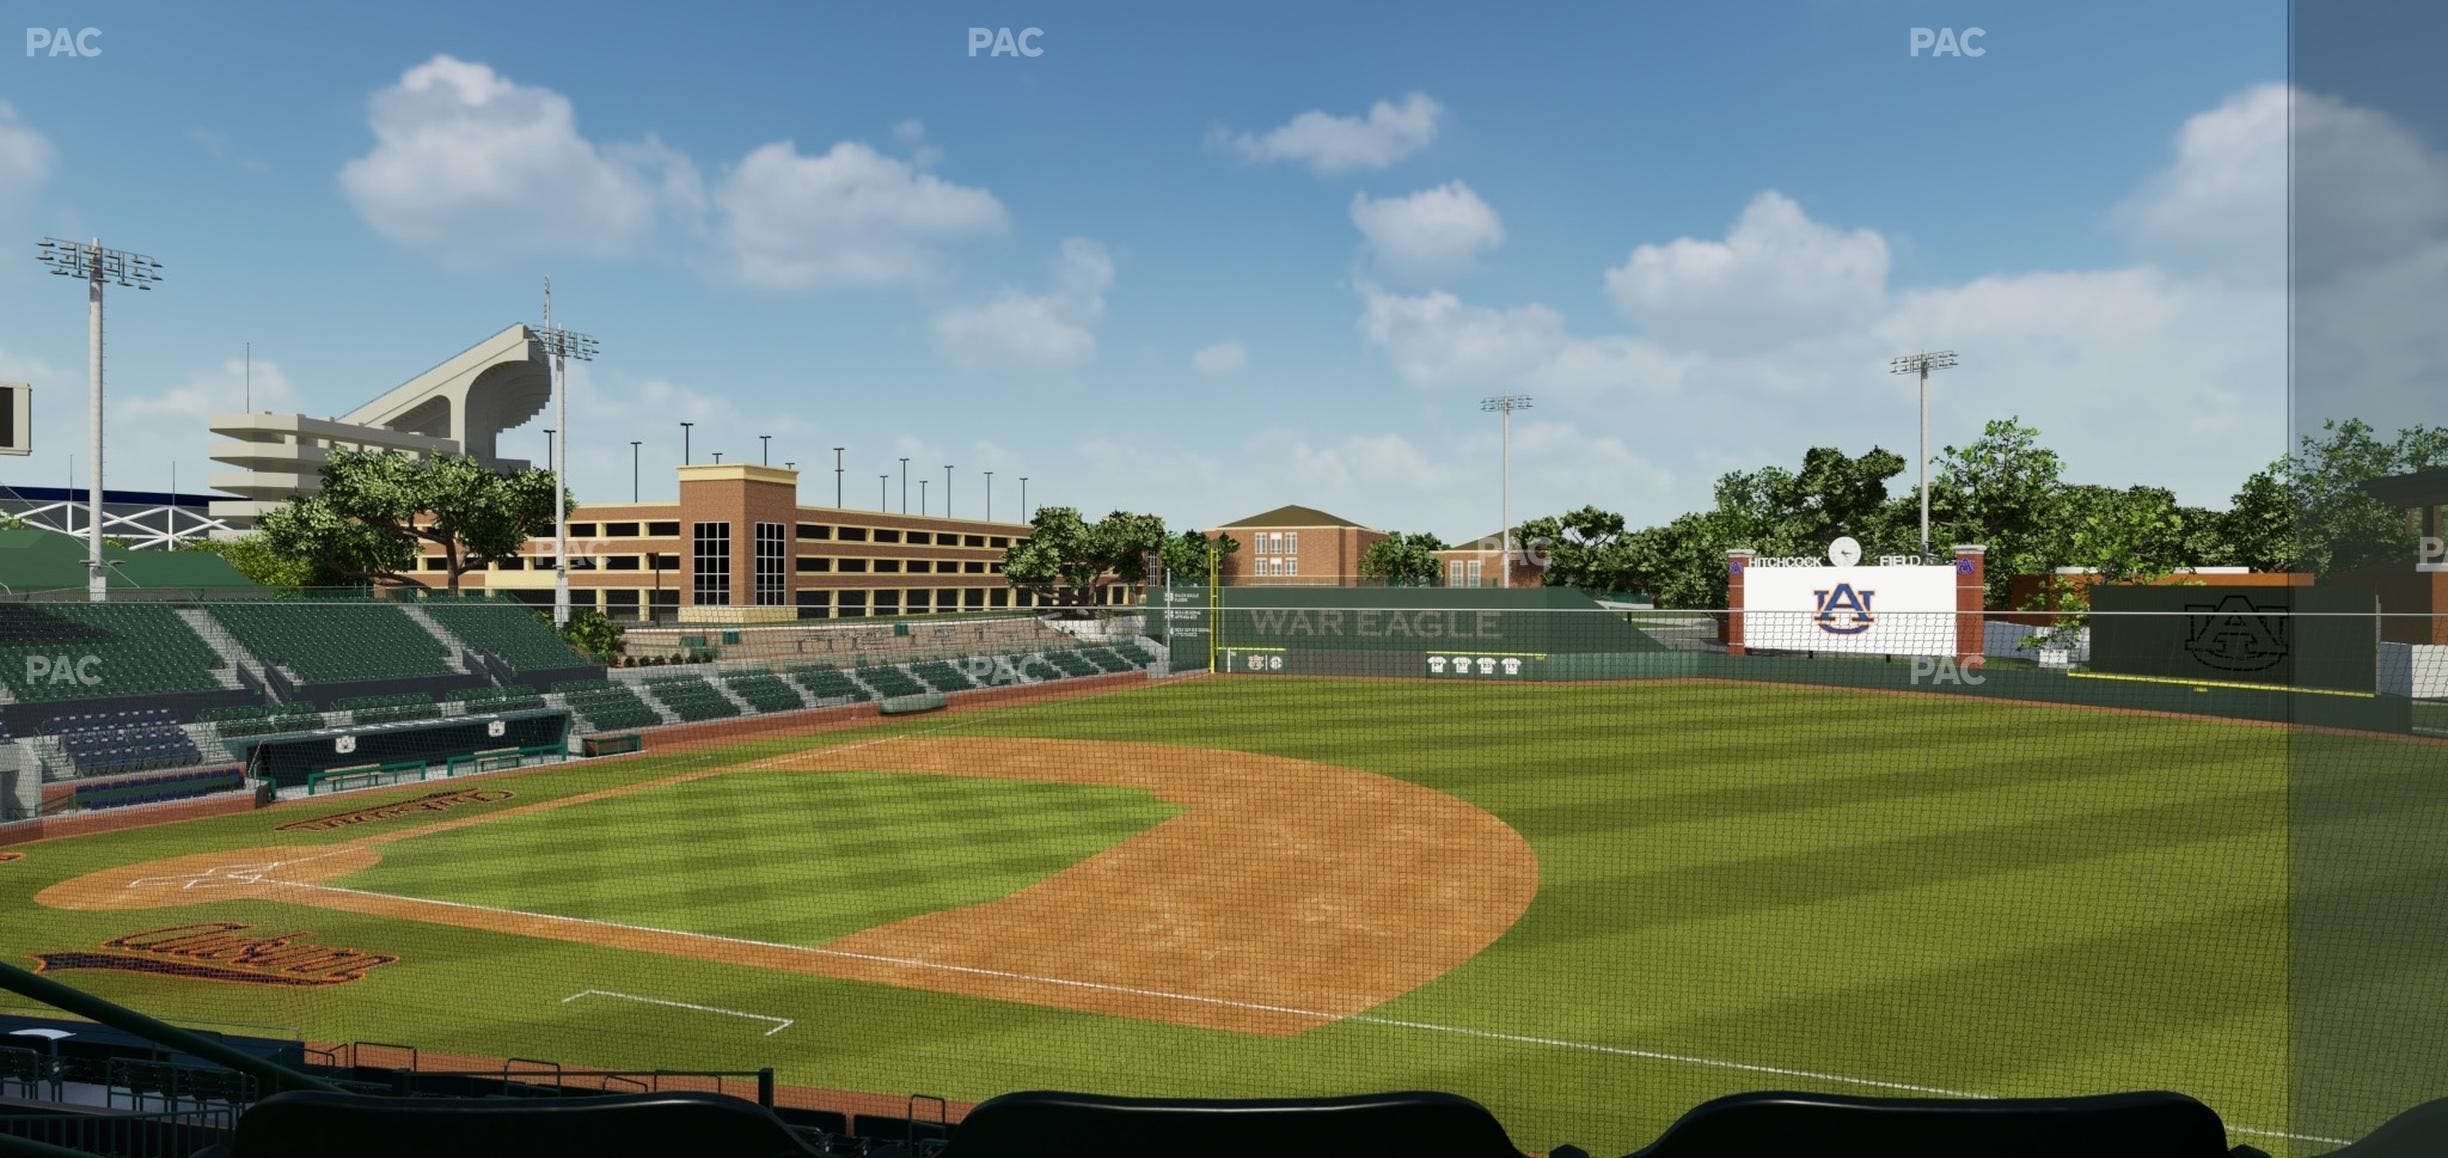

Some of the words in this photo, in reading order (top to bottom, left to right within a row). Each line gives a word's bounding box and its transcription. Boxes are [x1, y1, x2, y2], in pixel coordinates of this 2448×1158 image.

[1749, 556, 1824, 568] HITCHCOCK
[1880, 555, 1921, 567] FIELD
[1251, 609, 1344, 637] WAR
[1357, 609, 1503, 639] EAGLE
